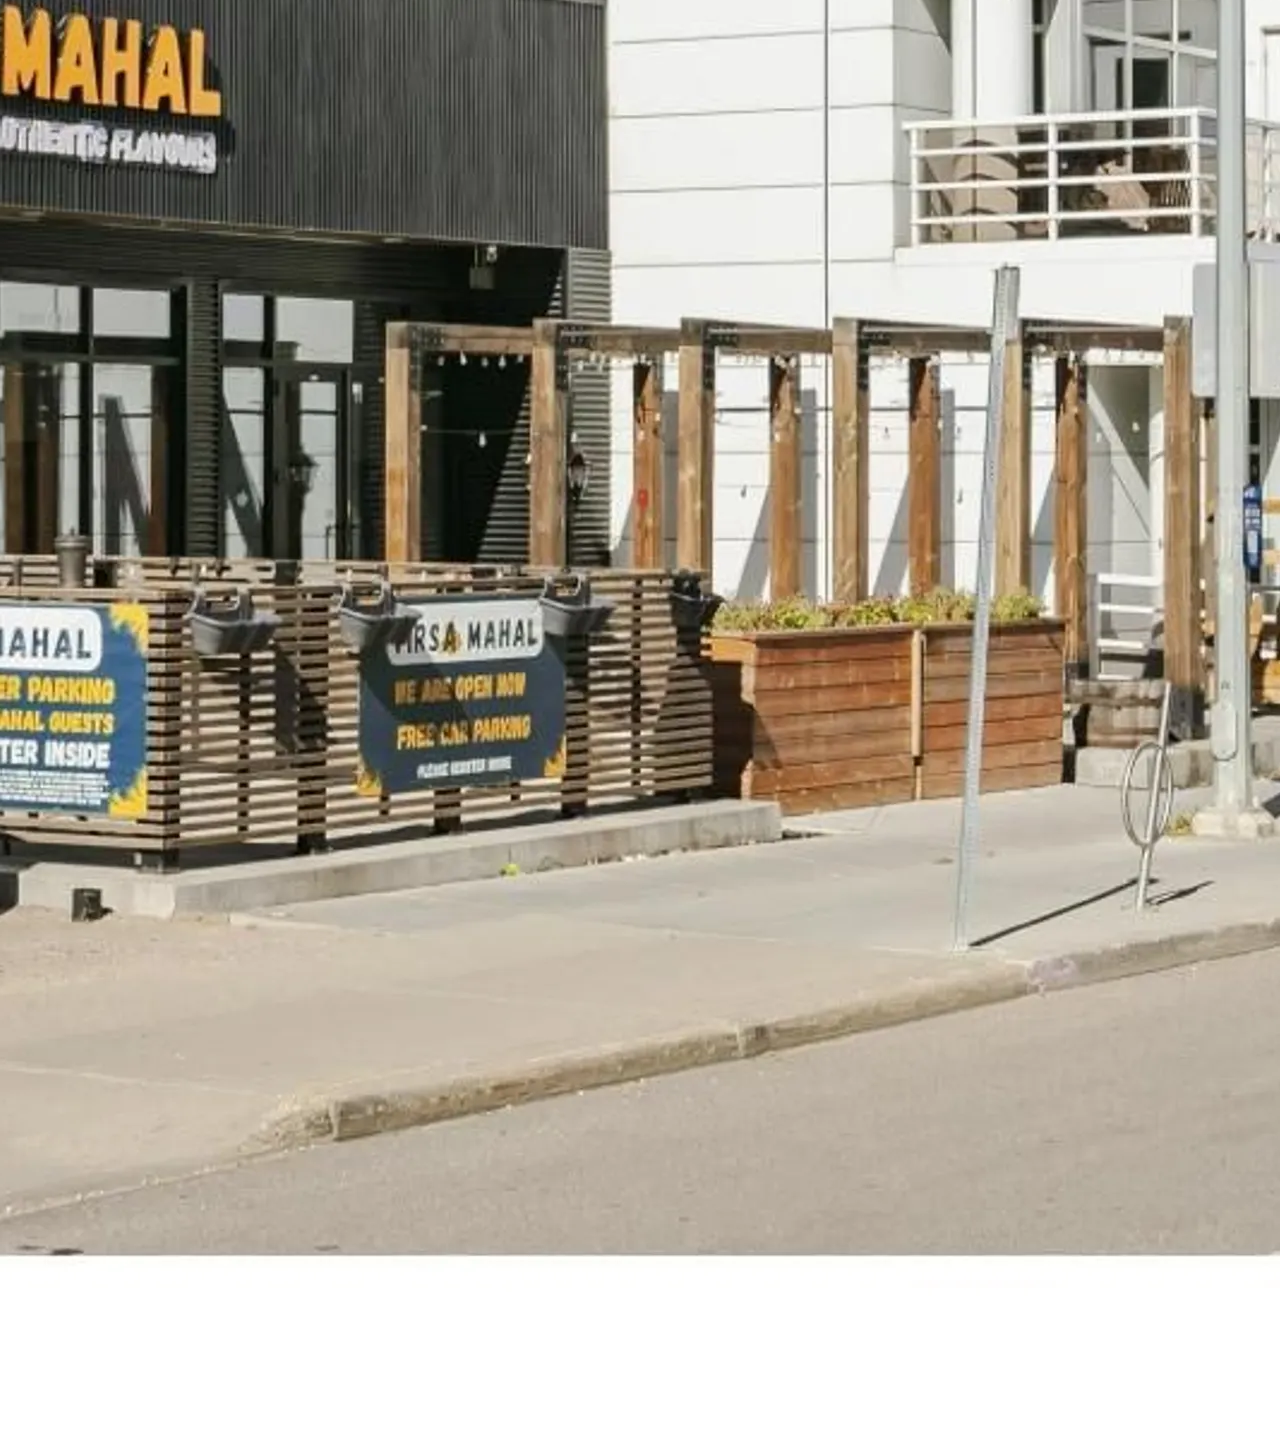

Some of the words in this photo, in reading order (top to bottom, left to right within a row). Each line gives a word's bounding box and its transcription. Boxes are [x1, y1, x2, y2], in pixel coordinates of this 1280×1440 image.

[2, 4, 221, 117] MAHAL
[110, 129, 217, 174] FLAVOURS
[467, 618, 538, 651] MAHAL
[28, 675, 116, 705] PARKING
[455, 673, 492, 701] OPEN
[49, 712, 115, 736] GUESTS
[397, 723, 436, 750] FREE
[44, 740, 112, 769] INSIDE
